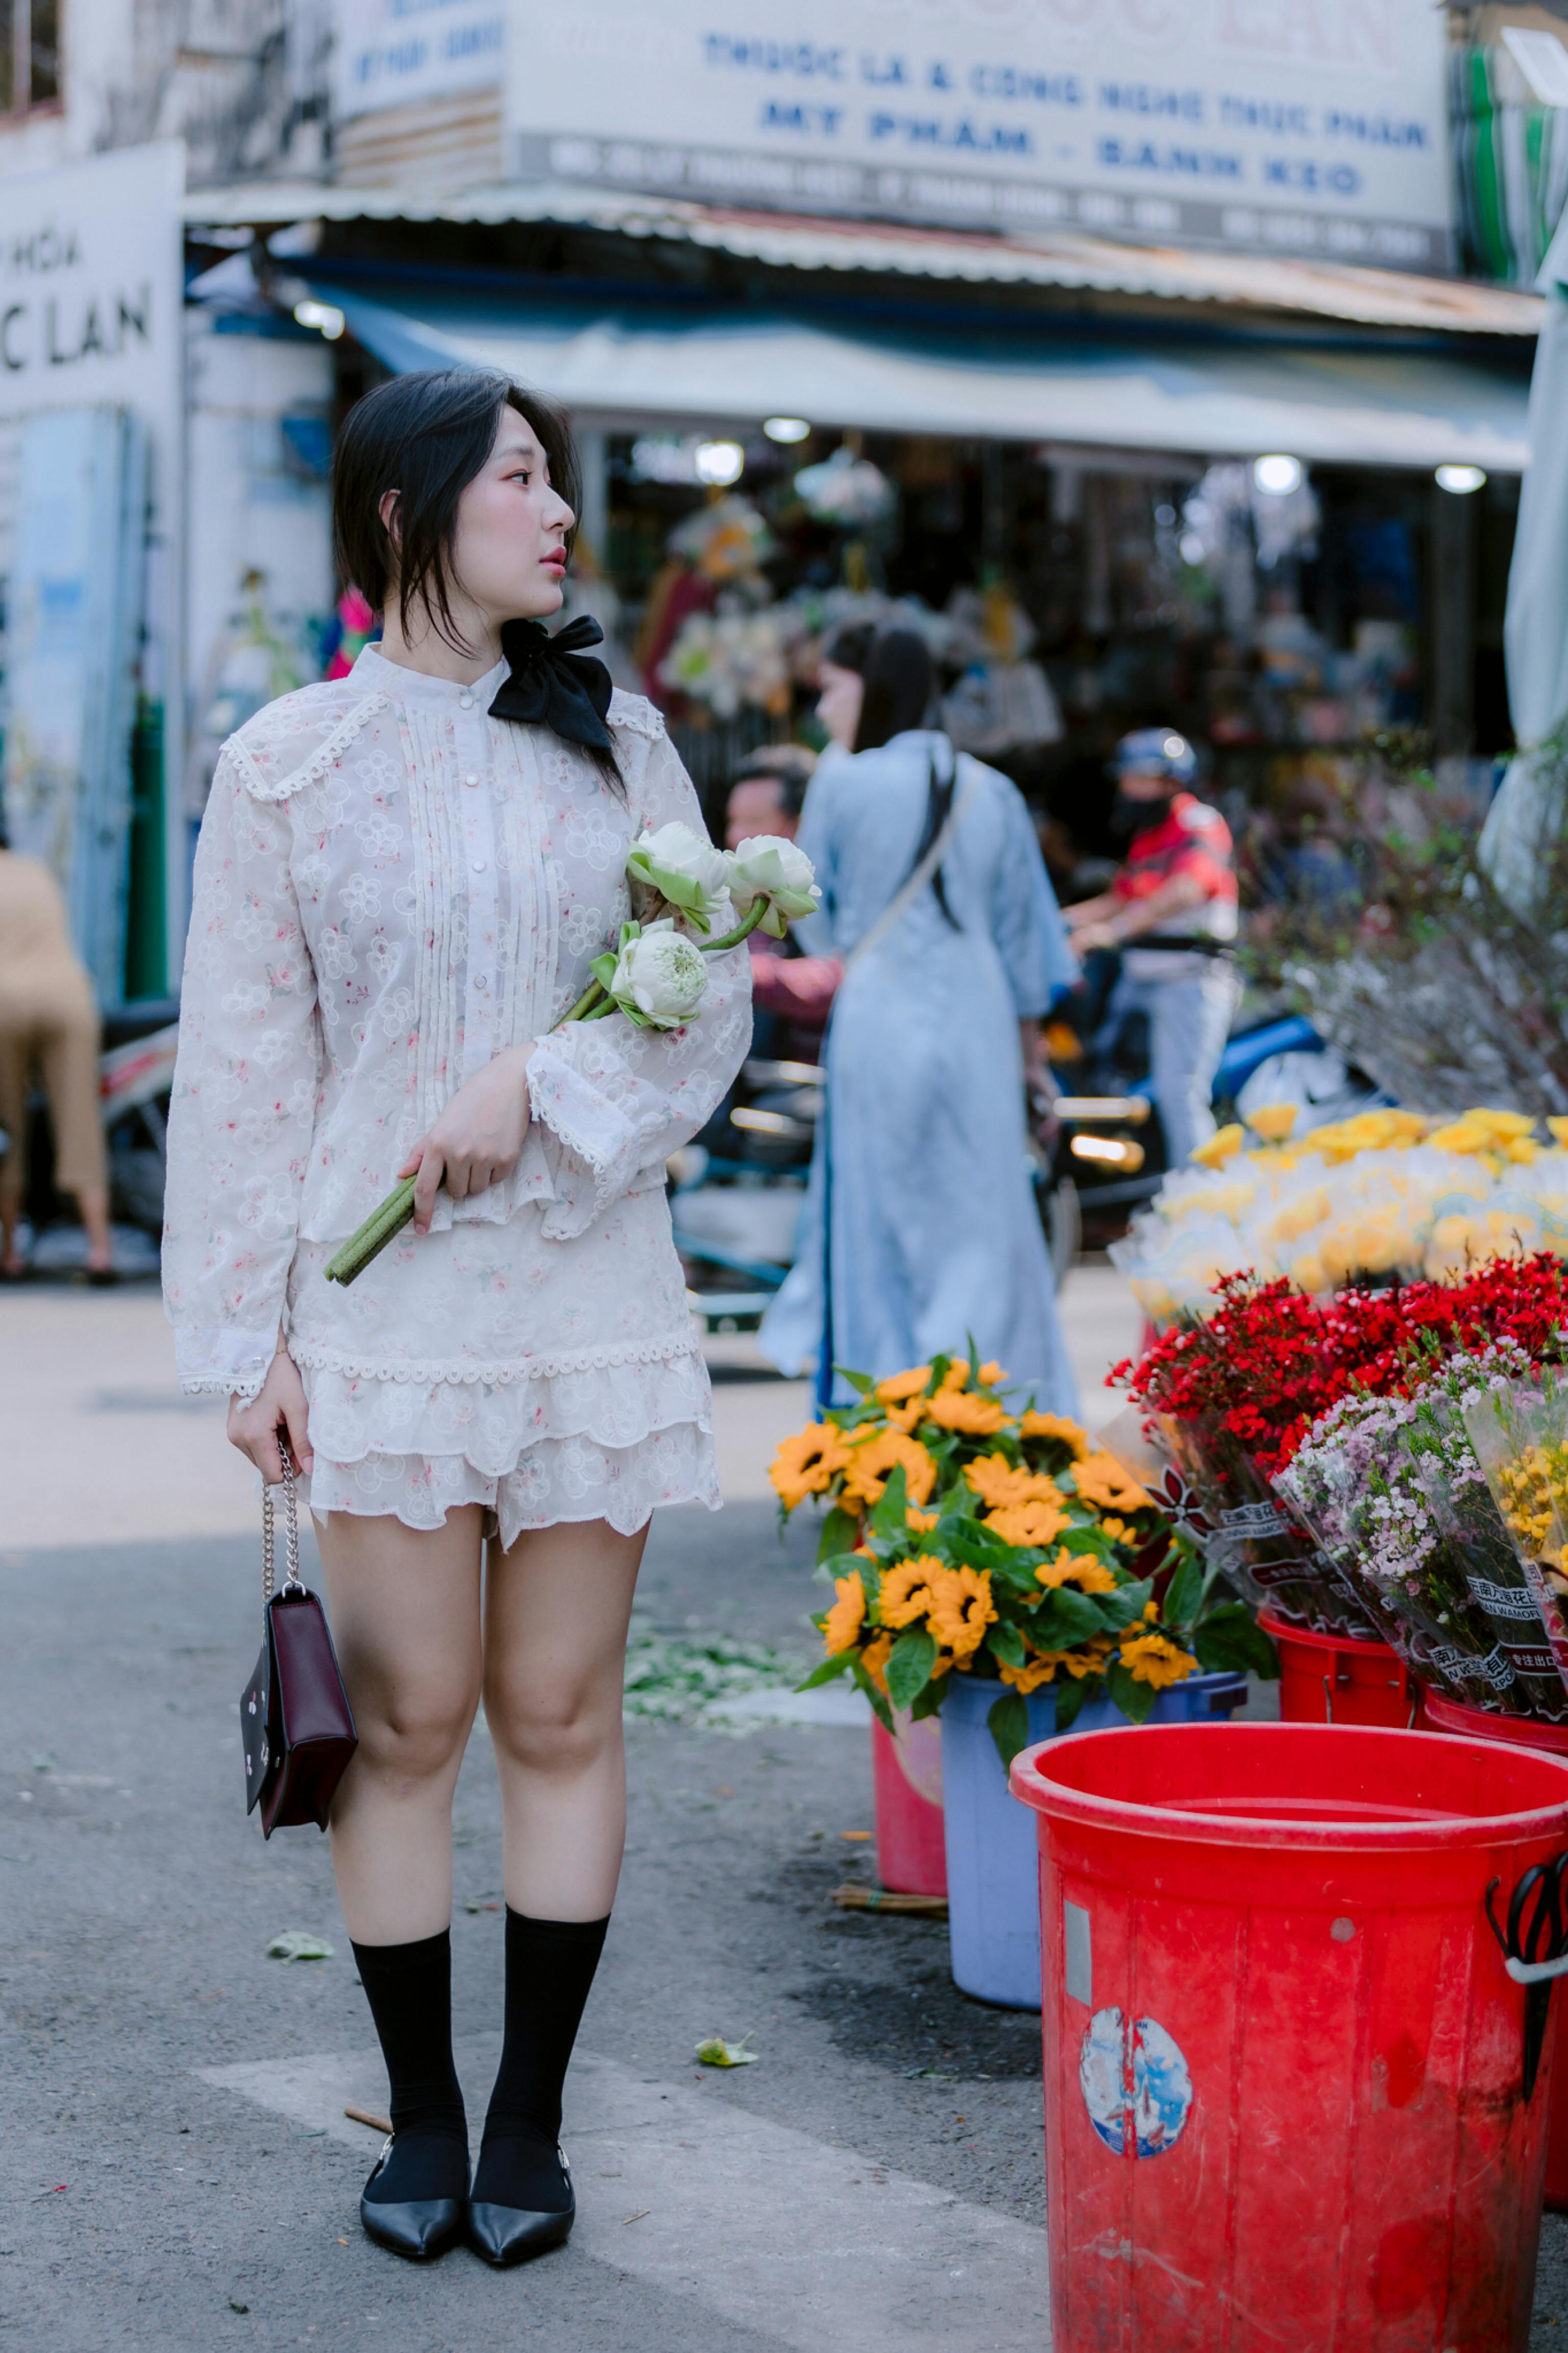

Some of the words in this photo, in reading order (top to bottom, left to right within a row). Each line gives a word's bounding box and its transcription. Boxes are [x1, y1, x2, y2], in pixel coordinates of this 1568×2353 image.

[47, 285, 152, 367] LAN
[1512, 1654, 1556, 1667] 专注出口
